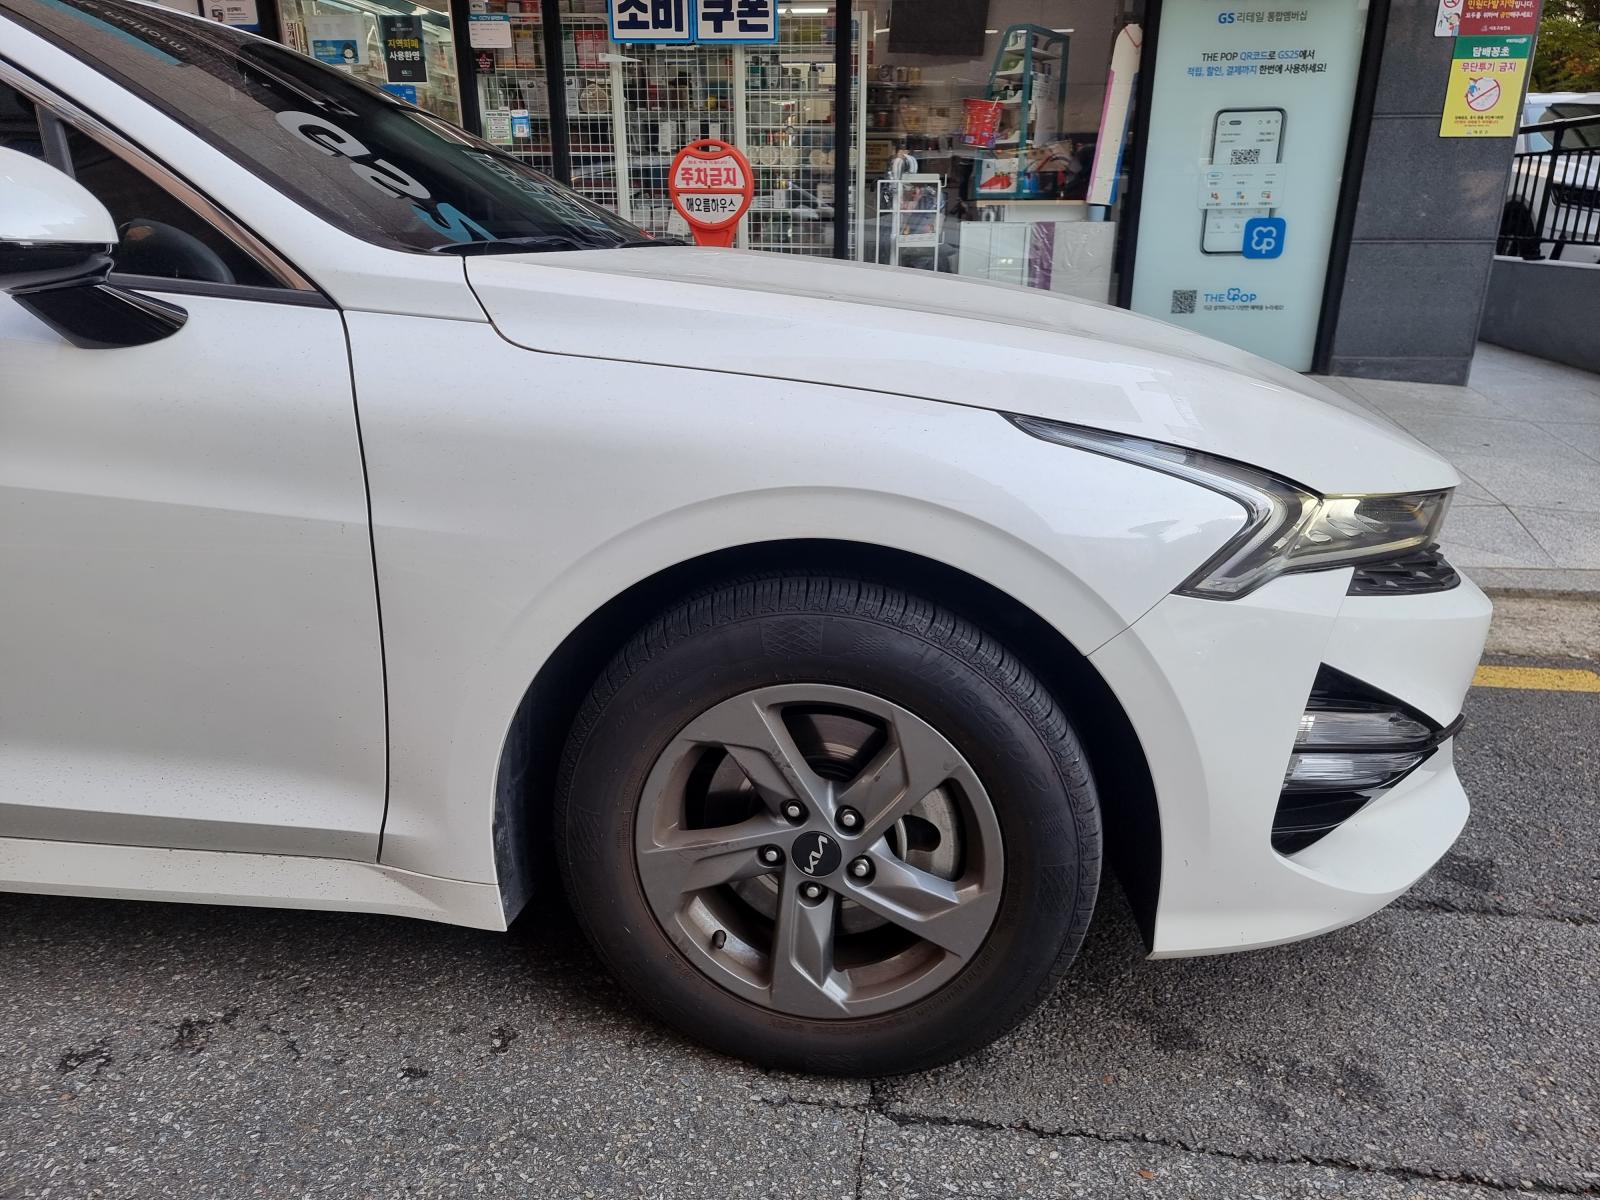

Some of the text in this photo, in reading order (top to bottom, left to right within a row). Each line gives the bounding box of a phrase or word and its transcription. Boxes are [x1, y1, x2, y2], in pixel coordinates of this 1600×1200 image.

[1218, 12, 1235, 24] GS
[1236, 11, 1264, 23] 리테일
[388, 38, 419, 49] 지역화폐
[389, 50, 420, 61] 사용환영
[1201, 49, 1315, 61] THE POP QR코드로 GS25에서
[1472, 46, 1510, 57] 담배꽁초
[1259, 64, 1283, 75] 한번에
[1284, 63, 1328, 74] 사용하세요!
[1461, 62, 1516, 72] 무단투기 금지
[681, 167, 737, 186] 주차금지
[686, 198, 736, 212] 해오름하우스
[1204, 289, 1257, 303] THE POP
